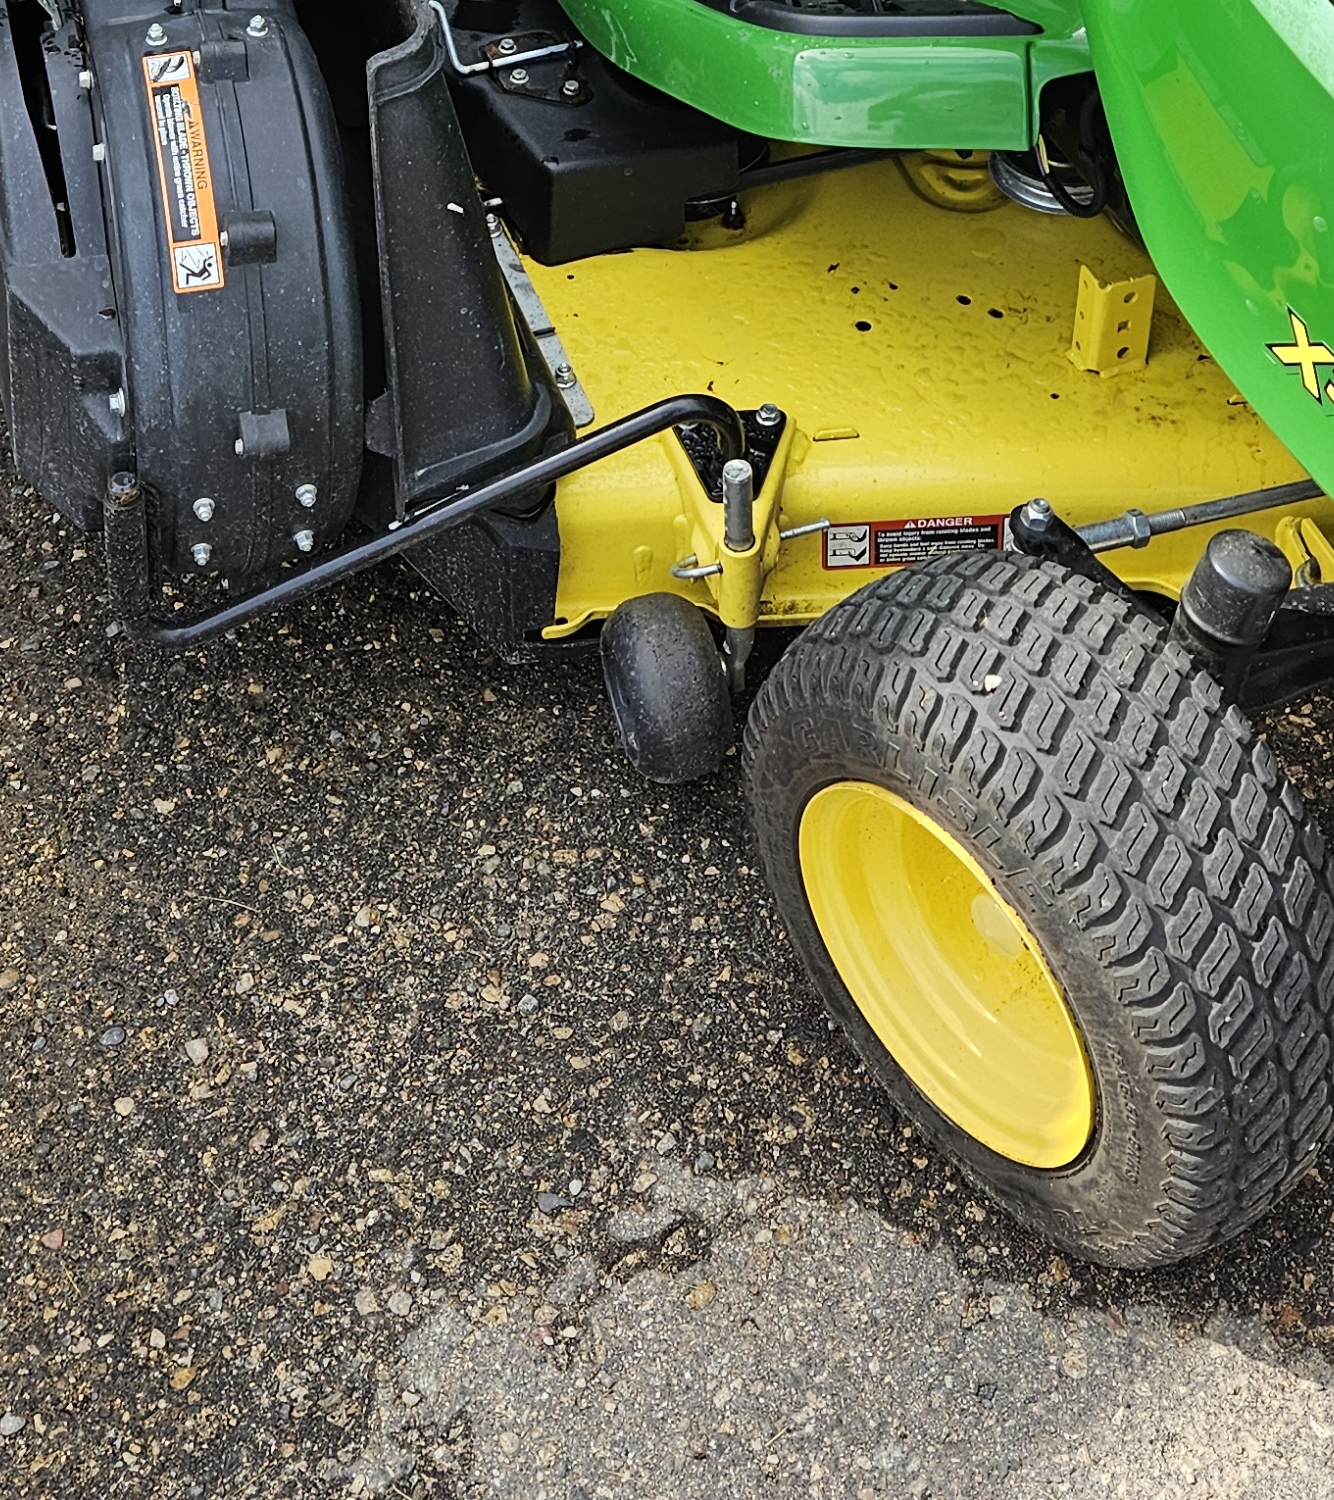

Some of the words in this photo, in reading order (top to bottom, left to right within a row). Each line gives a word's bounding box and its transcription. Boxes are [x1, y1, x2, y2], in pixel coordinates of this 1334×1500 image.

[176, 122, 188, 150] BLADE
[180, 153, 194, 193] THROWN
[189, 129, 208, 190] WARNING
[186, 192, 200, 236] OBJECTS
[917, 517, 973, 529] DANGER
[790, 711, 1055, 913] CARLISLE
